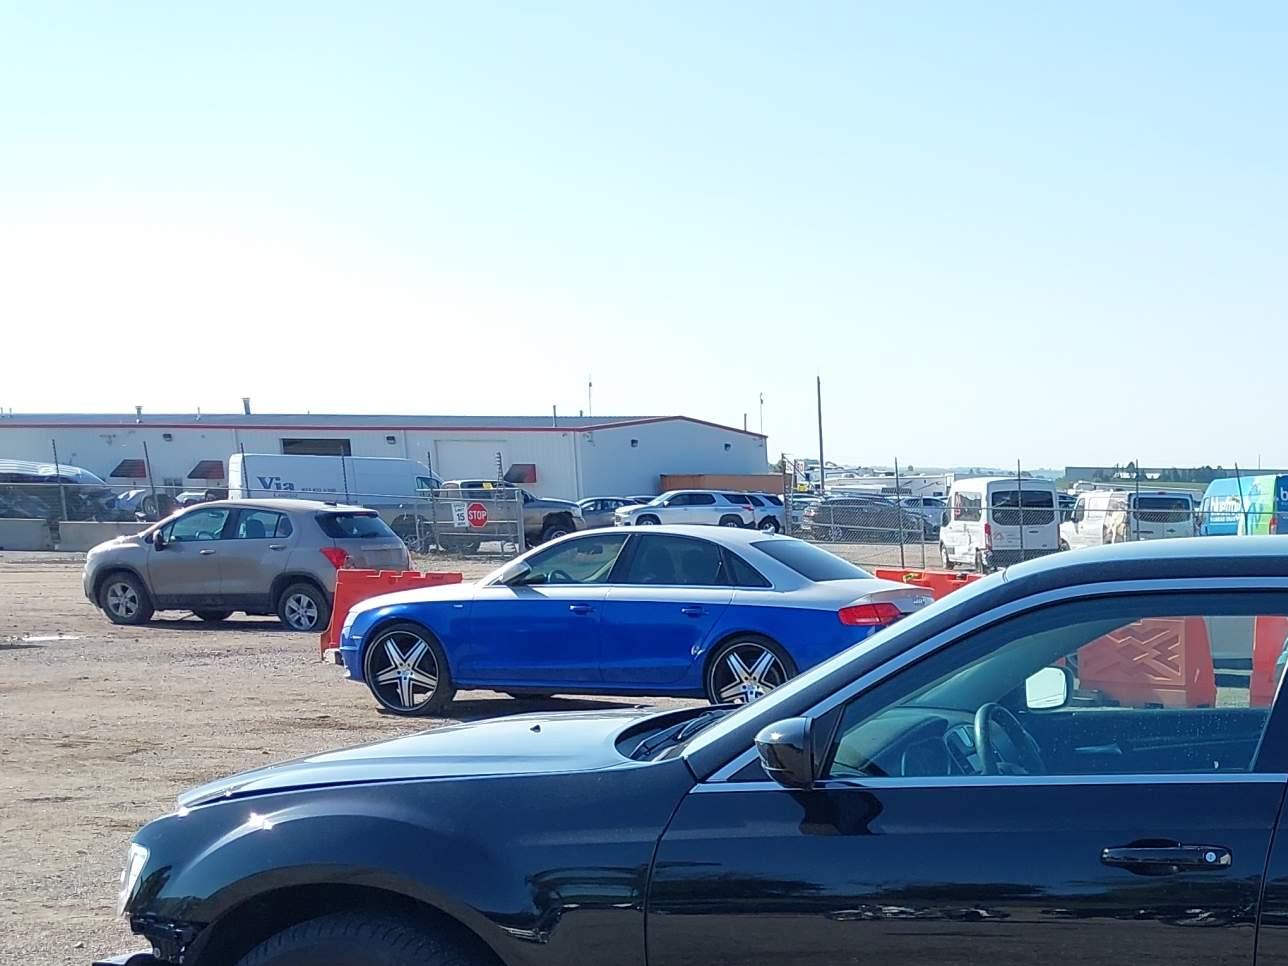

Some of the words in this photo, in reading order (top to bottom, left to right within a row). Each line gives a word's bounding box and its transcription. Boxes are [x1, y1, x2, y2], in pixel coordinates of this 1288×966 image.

[256, 476, 296, 491] Via
[457, 512, 465, 521] 15
[468, 510, 487, 520] STOP
